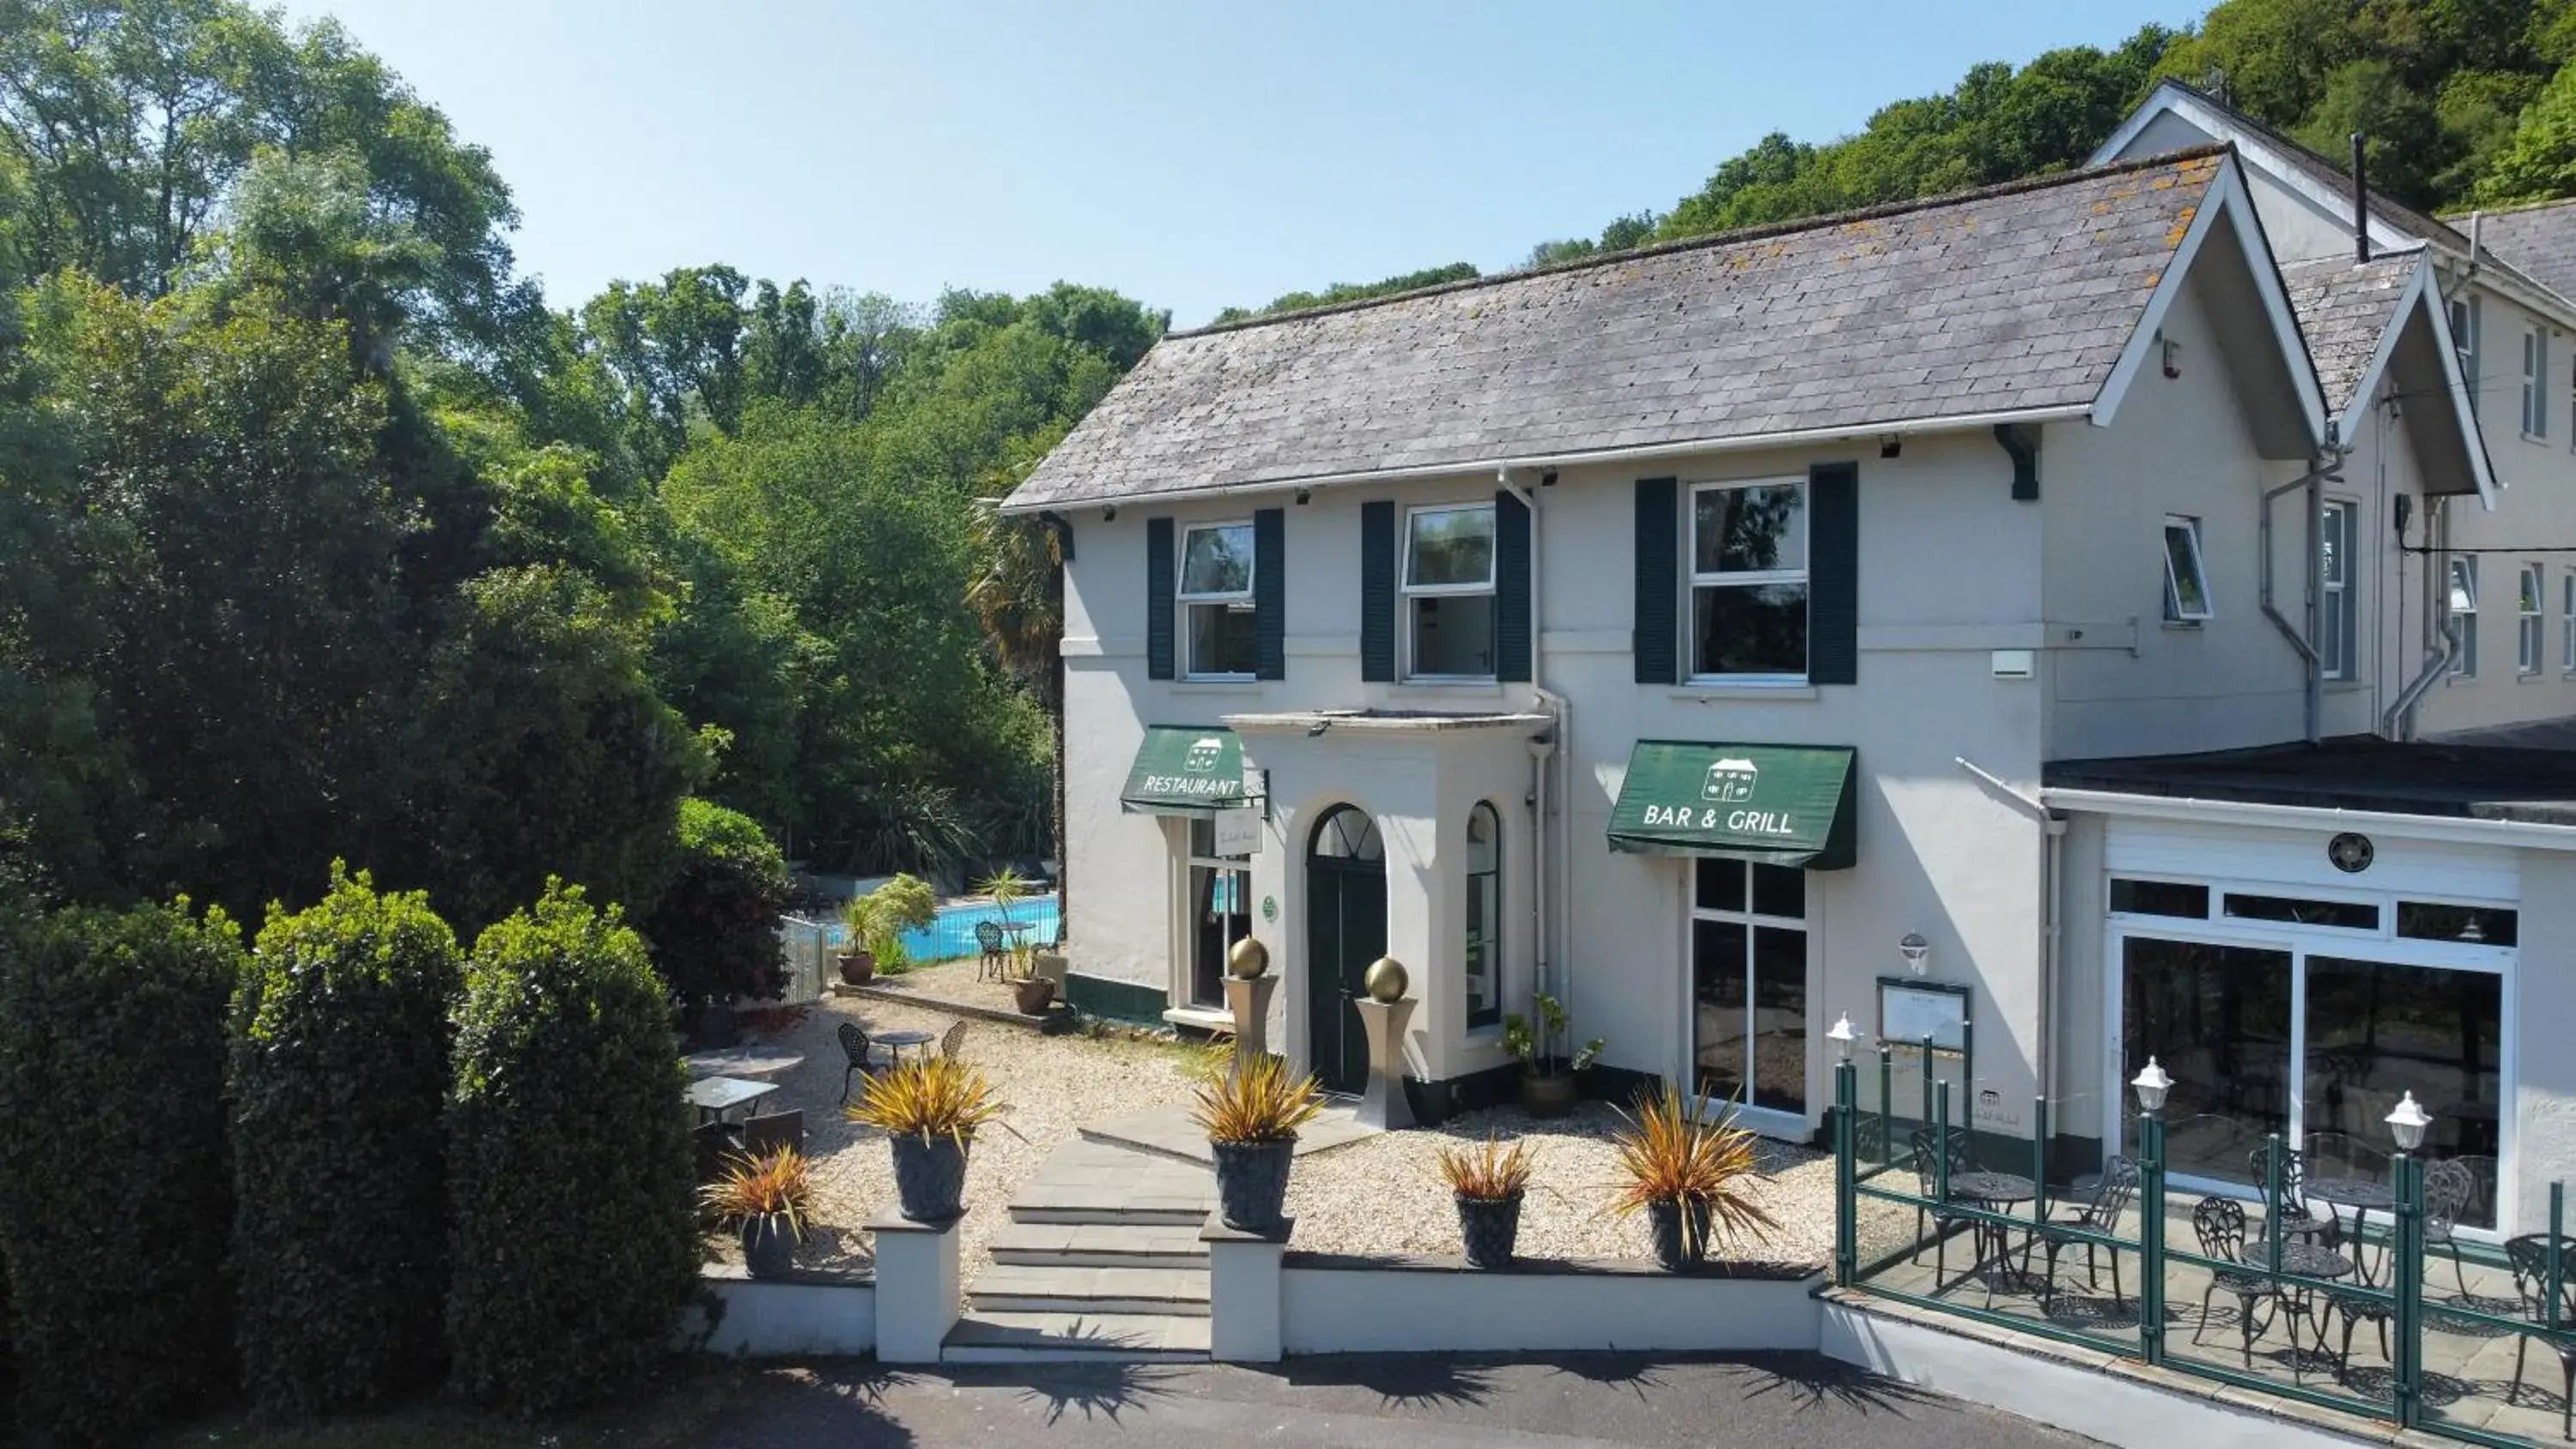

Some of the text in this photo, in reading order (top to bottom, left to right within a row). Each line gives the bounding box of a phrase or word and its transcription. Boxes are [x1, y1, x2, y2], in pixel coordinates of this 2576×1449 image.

[1144, 775, 1239, 796] RESTAURANT
[1643, 804, 1793, 834] BAR & GRILL
